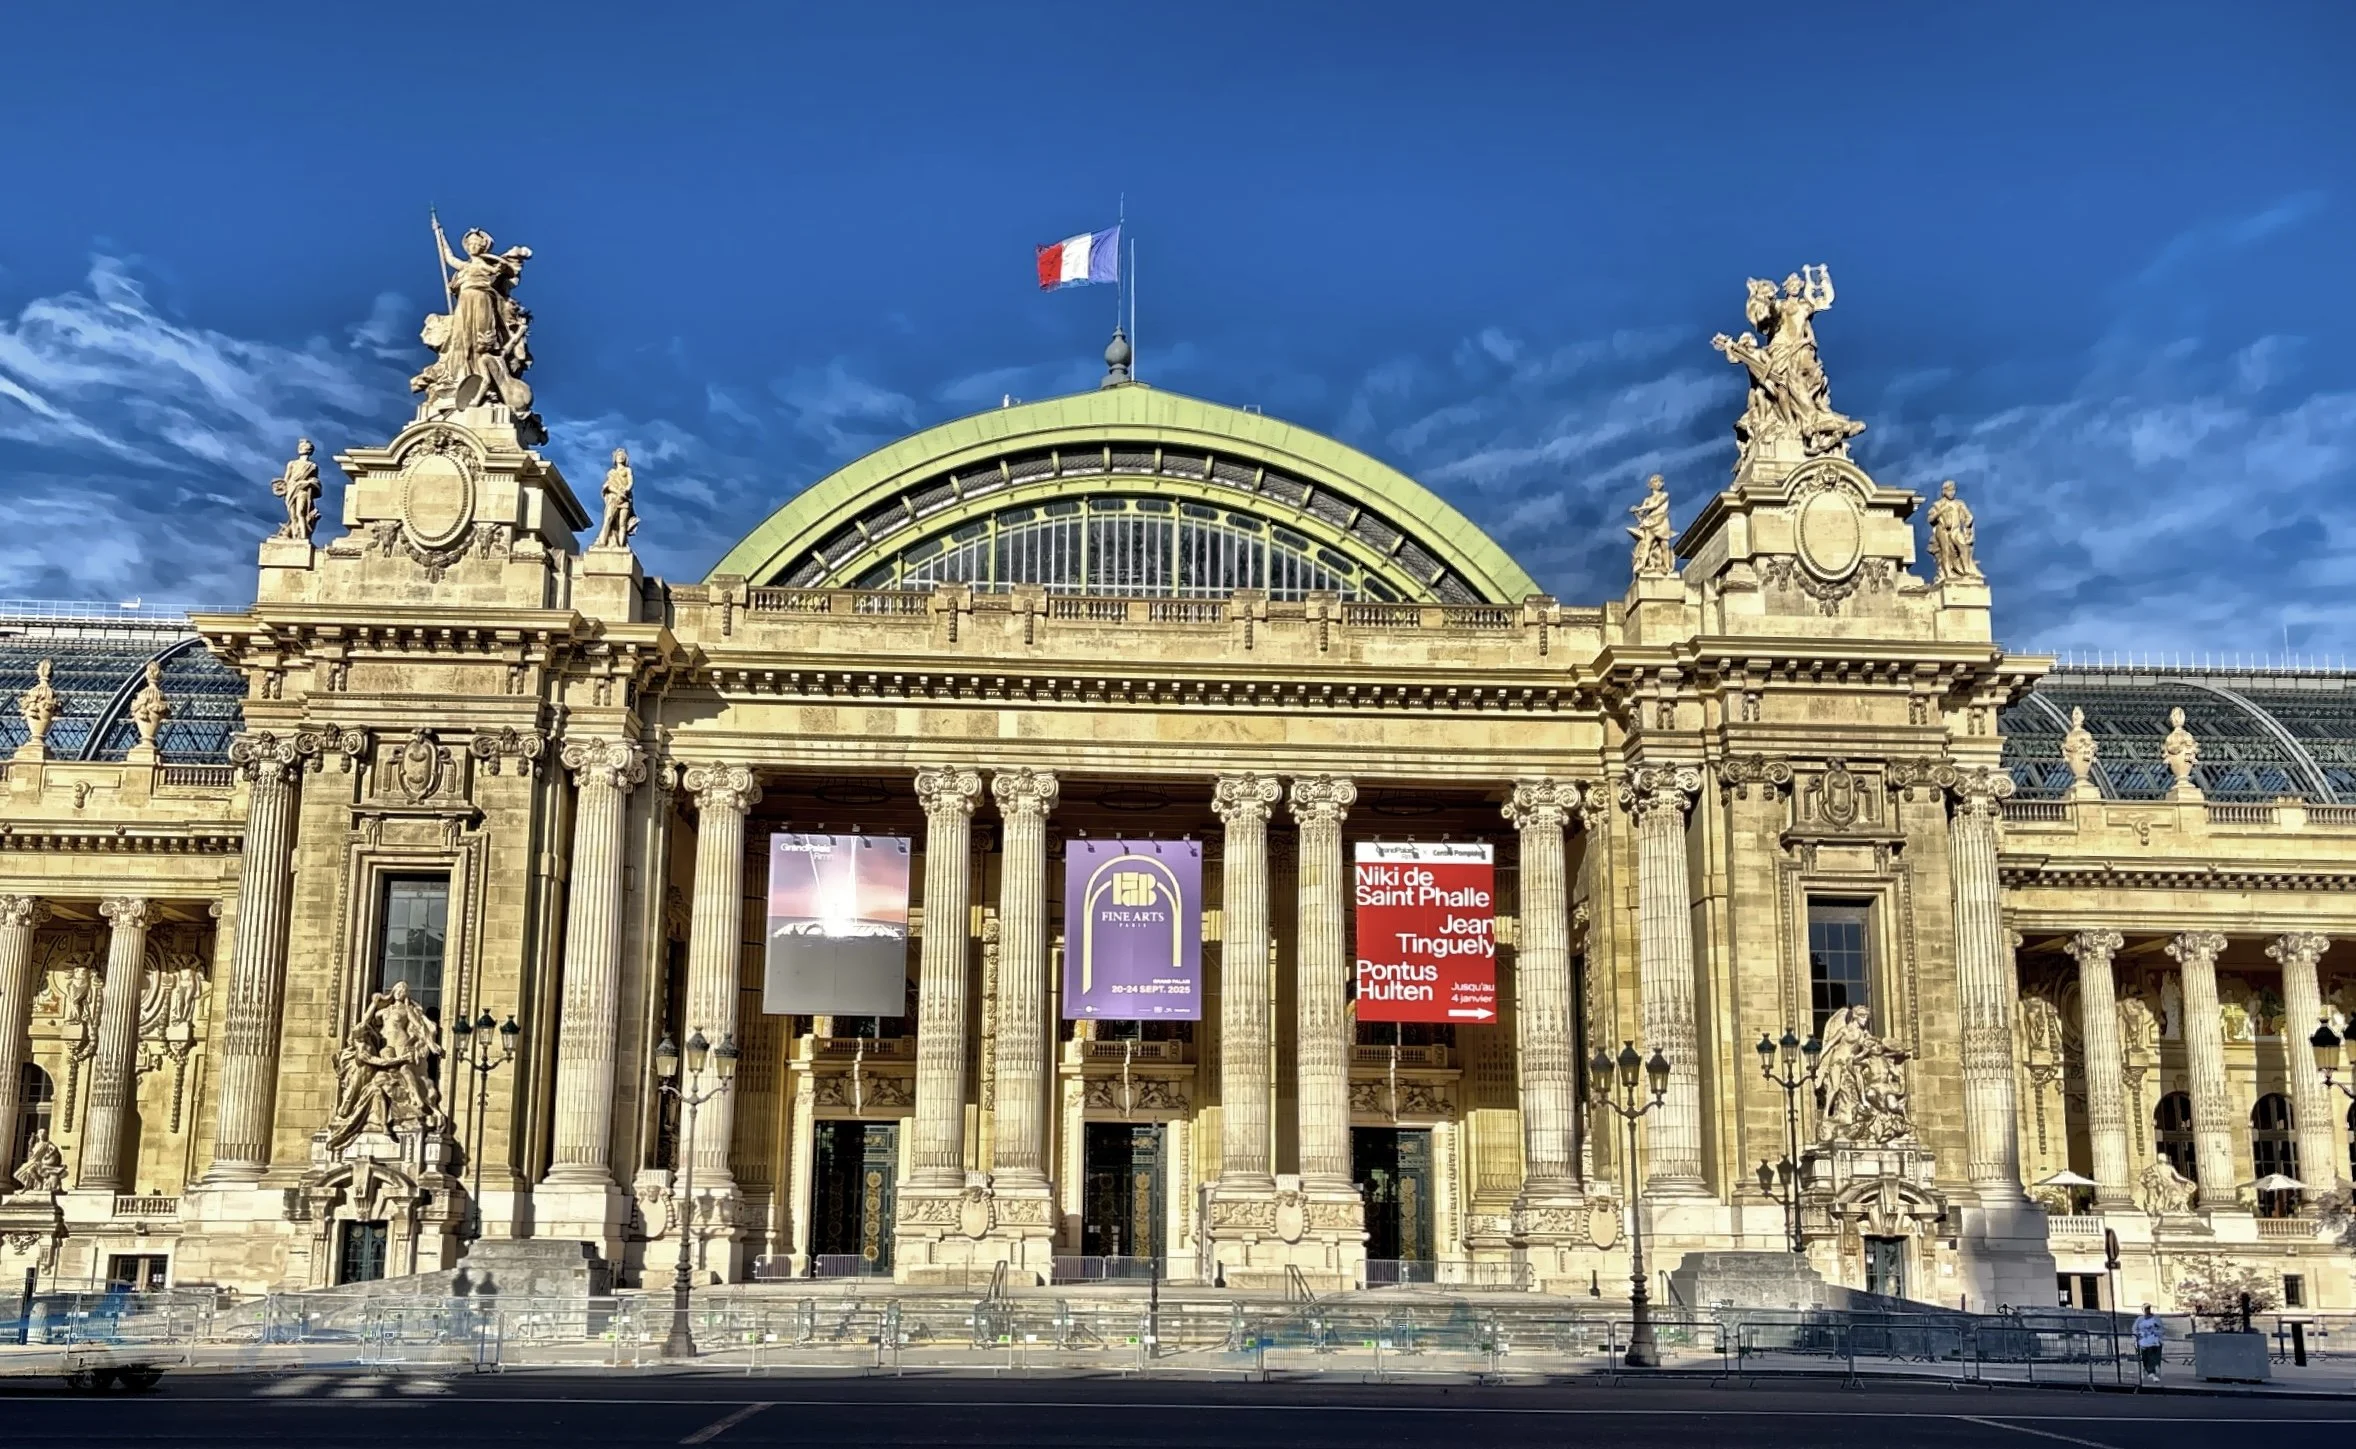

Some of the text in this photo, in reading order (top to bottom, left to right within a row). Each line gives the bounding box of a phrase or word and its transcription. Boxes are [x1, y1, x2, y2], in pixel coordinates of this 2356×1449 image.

[1355, 866, 1434, 887] Niki de
[1355, 885, 1490, 907] Saint Phalle
[1101, 911, 1165, 922] FINE ARTS
[1439, 914, 1495, 934] Jean
[1395, 933, 1495, 958] Tinguely
[1356, 959, 1438, 981] Pontus
[1111, 985, 1191, 994] 20-24 SEPT. 2025
[1356, 980, 1433, 1001] Hulten
[1451, 982, 1495, 992] Jusqu'au
[1451, 993, 1493, 1004] 4 janvier
